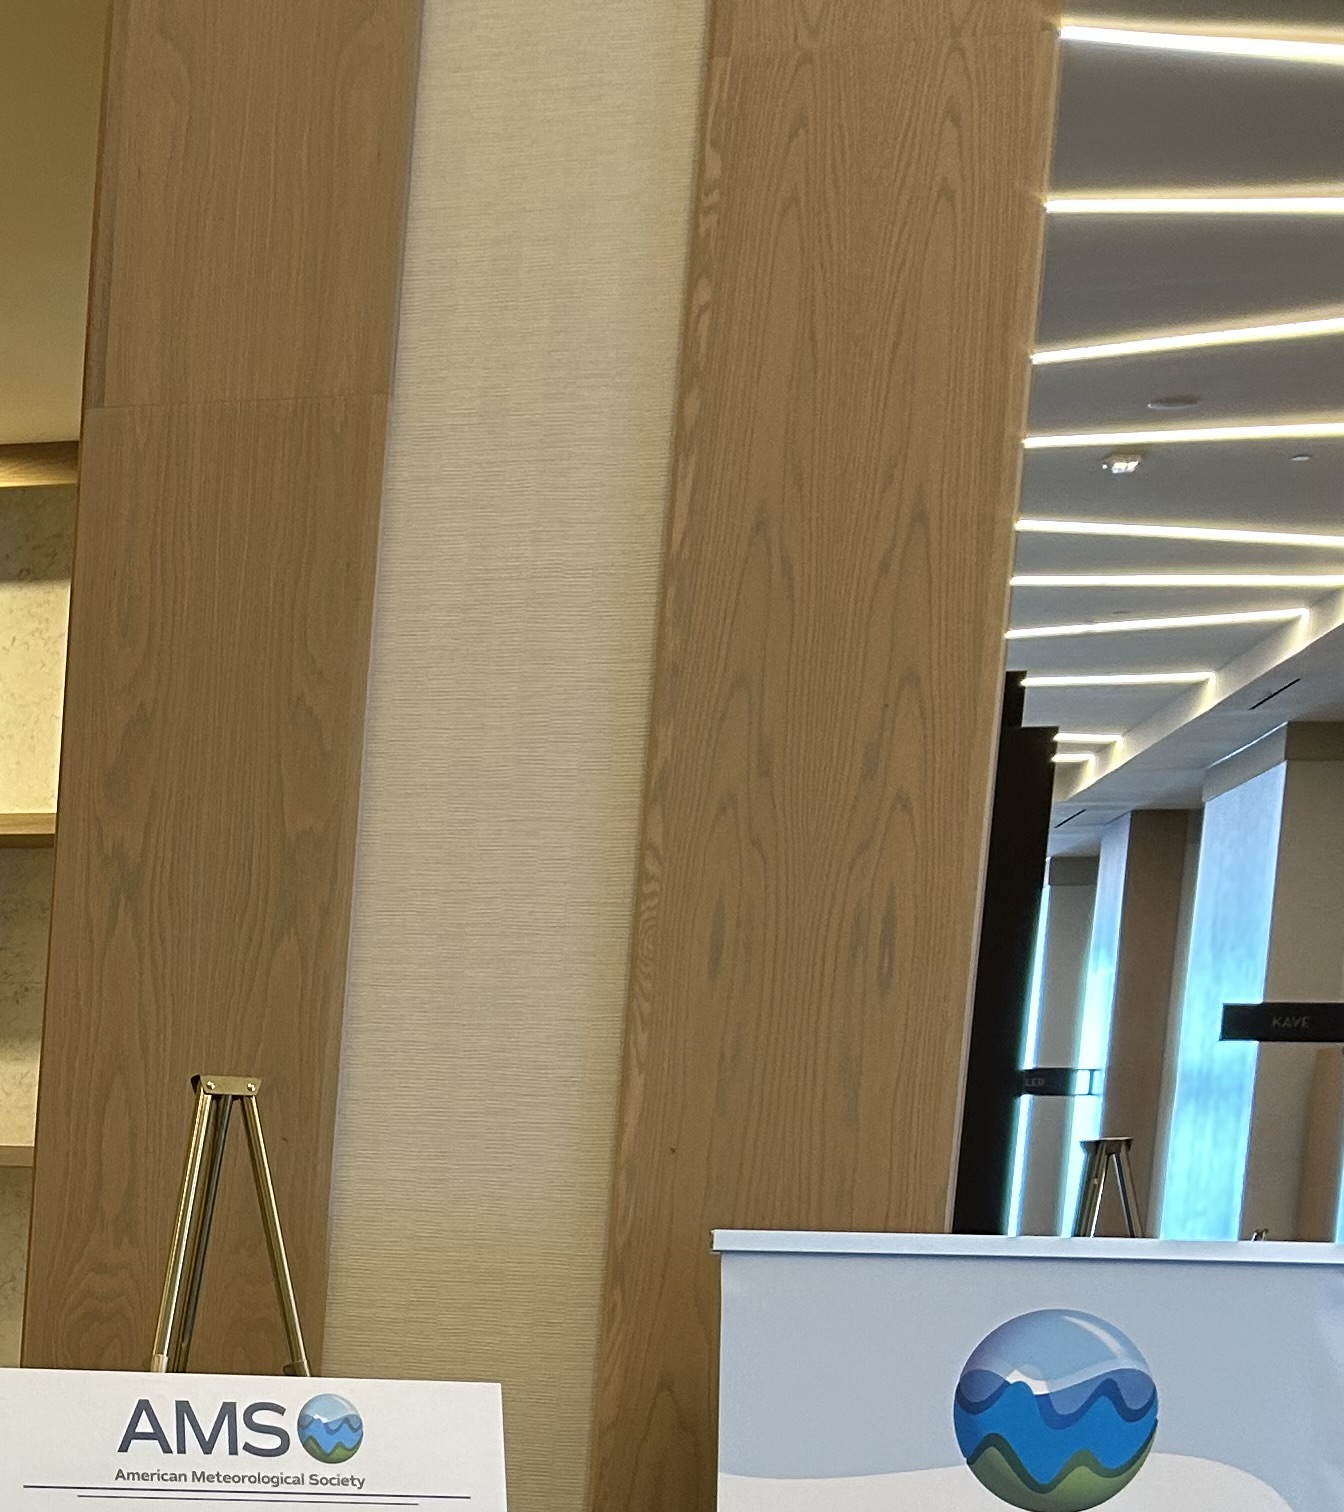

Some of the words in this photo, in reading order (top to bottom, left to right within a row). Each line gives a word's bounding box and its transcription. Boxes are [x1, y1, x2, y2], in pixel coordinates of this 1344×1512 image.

[117, 1398, 291, 1458] AMS
[114, 1469, 188, 1484] American
[192, 1470, 305, 1488] Meteorological
[309, 1473, 366, 1489] Society
